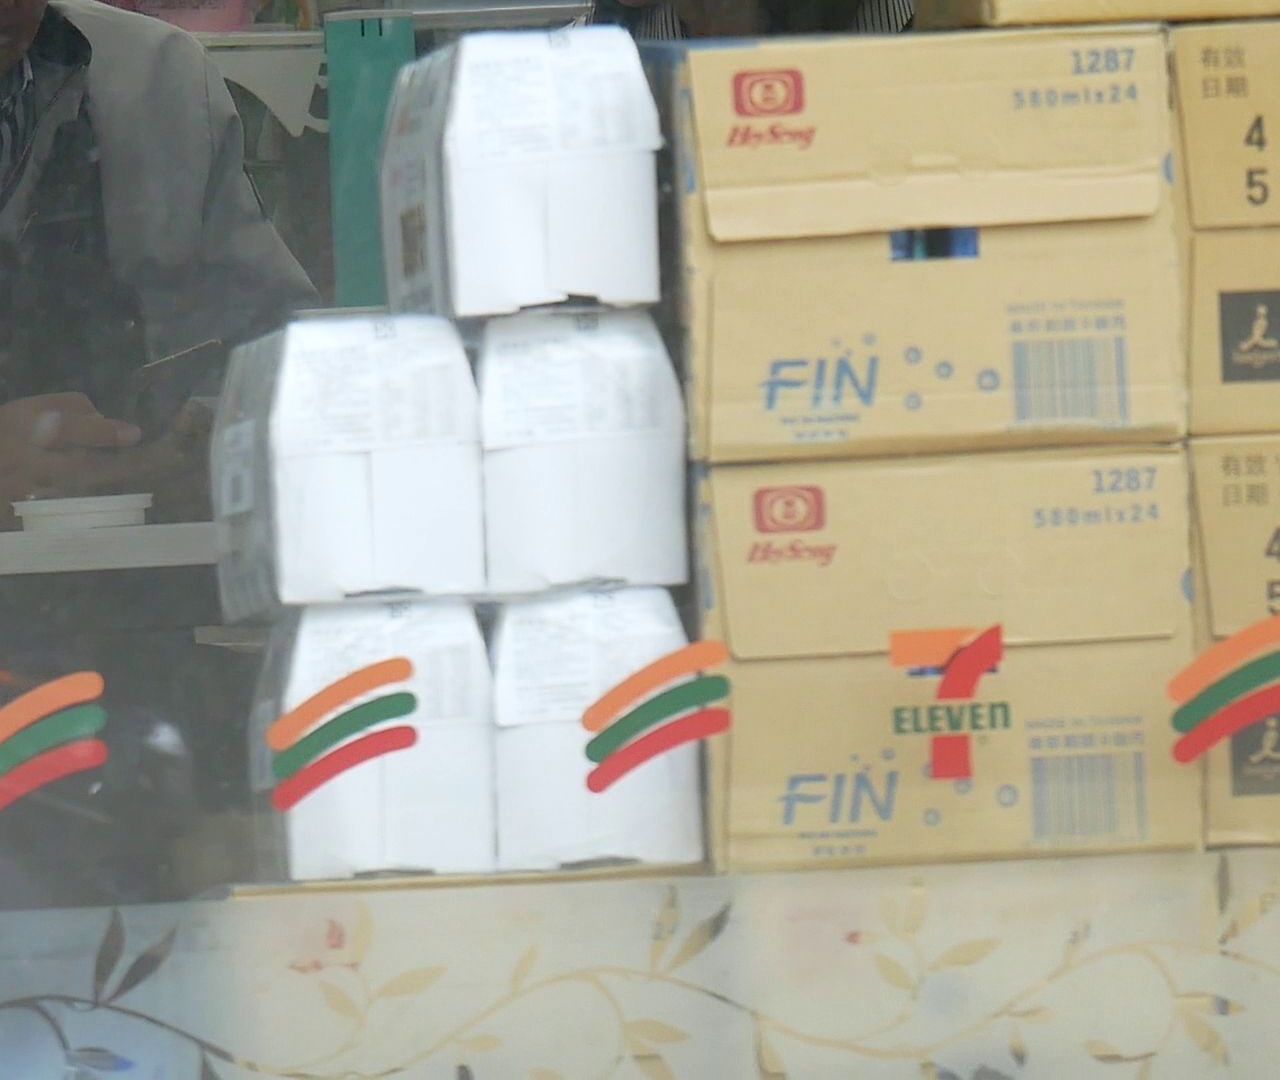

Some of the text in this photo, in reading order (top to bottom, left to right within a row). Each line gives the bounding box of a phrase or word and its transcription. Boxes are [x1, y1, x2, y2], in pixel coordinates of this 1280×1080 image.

[1072, 50, 1135, 75] 1287
[1244, 117, 1267, 151] 4
[1247, 169, 1269, 205] 5
[761, 356, 878, 410] FIN
[1093, 467, 1157, 493] 1287
[779, 769, 899, 825] FIN
